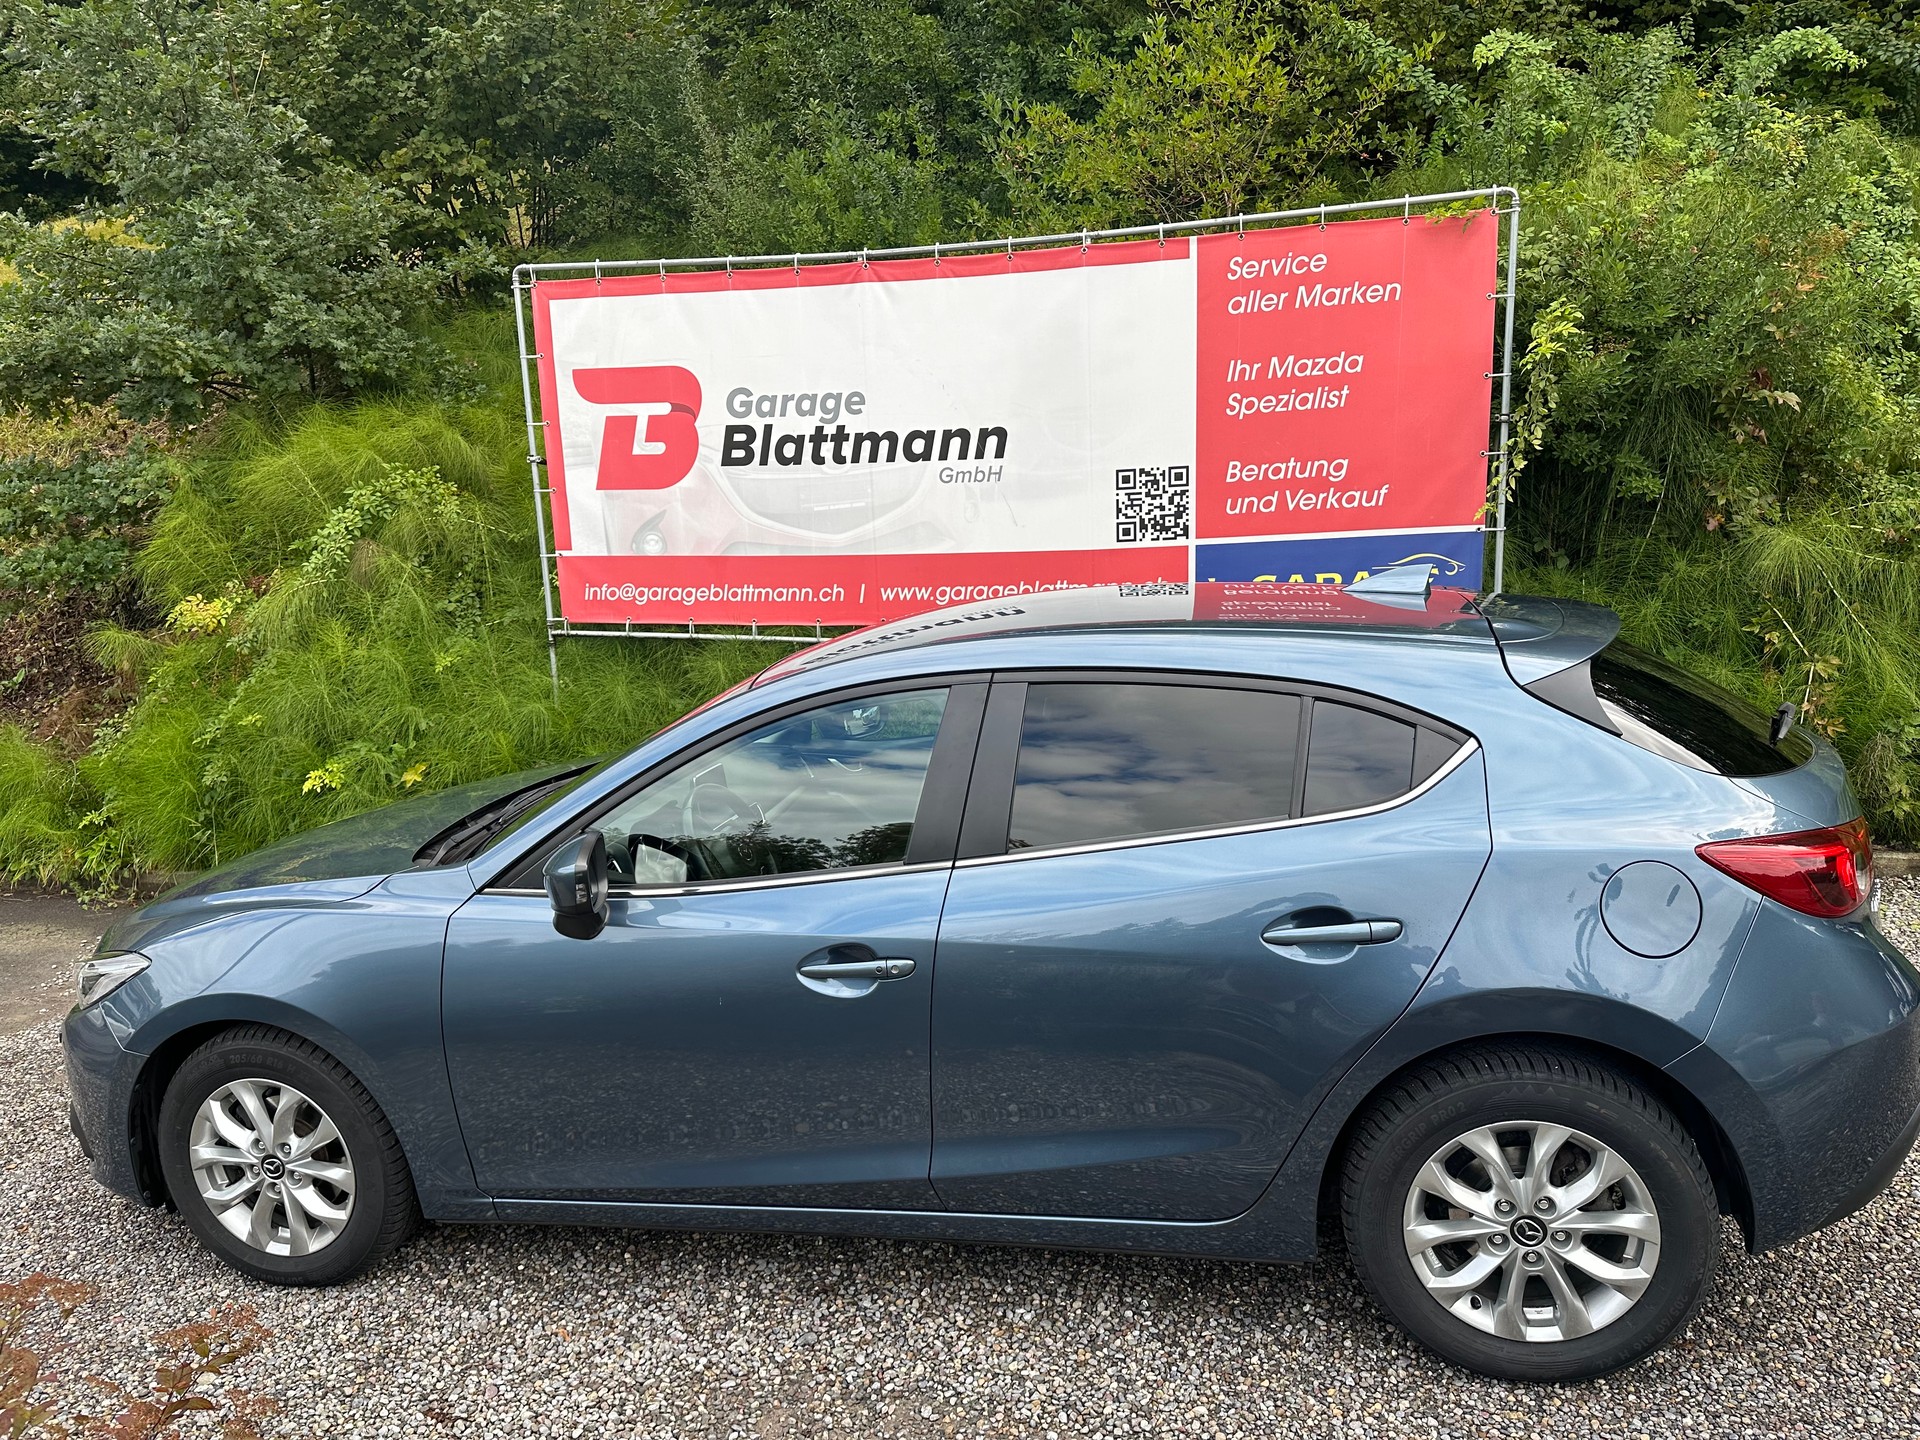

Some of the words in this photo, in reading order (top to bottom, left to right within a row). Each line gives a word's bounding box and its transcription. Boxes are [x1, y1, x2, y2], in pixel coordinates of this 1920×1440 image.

[1227, 252, 1327, 280] Service
[1227, 290, 1288, 315] aller
[1295, 281, 1401, 309] Marken
[1227, 359, 1261, 382] Ihr
[1267, 351, 1364, 379] Mazda
[726, 387, 865, 424] Garage
[1225, 385, 1350, 420] Spezialist
[720, 424, 1009, 467] Blattmann
[938, 465, 1003, 484] GmbH
[1225, 457, 1349, 483] Beratung
[1225, 491, 1279, 515] und
[1285, 484, 1390, 511] Verkauf
[584, 583, 845, 605] info@garageblattmann.ch
